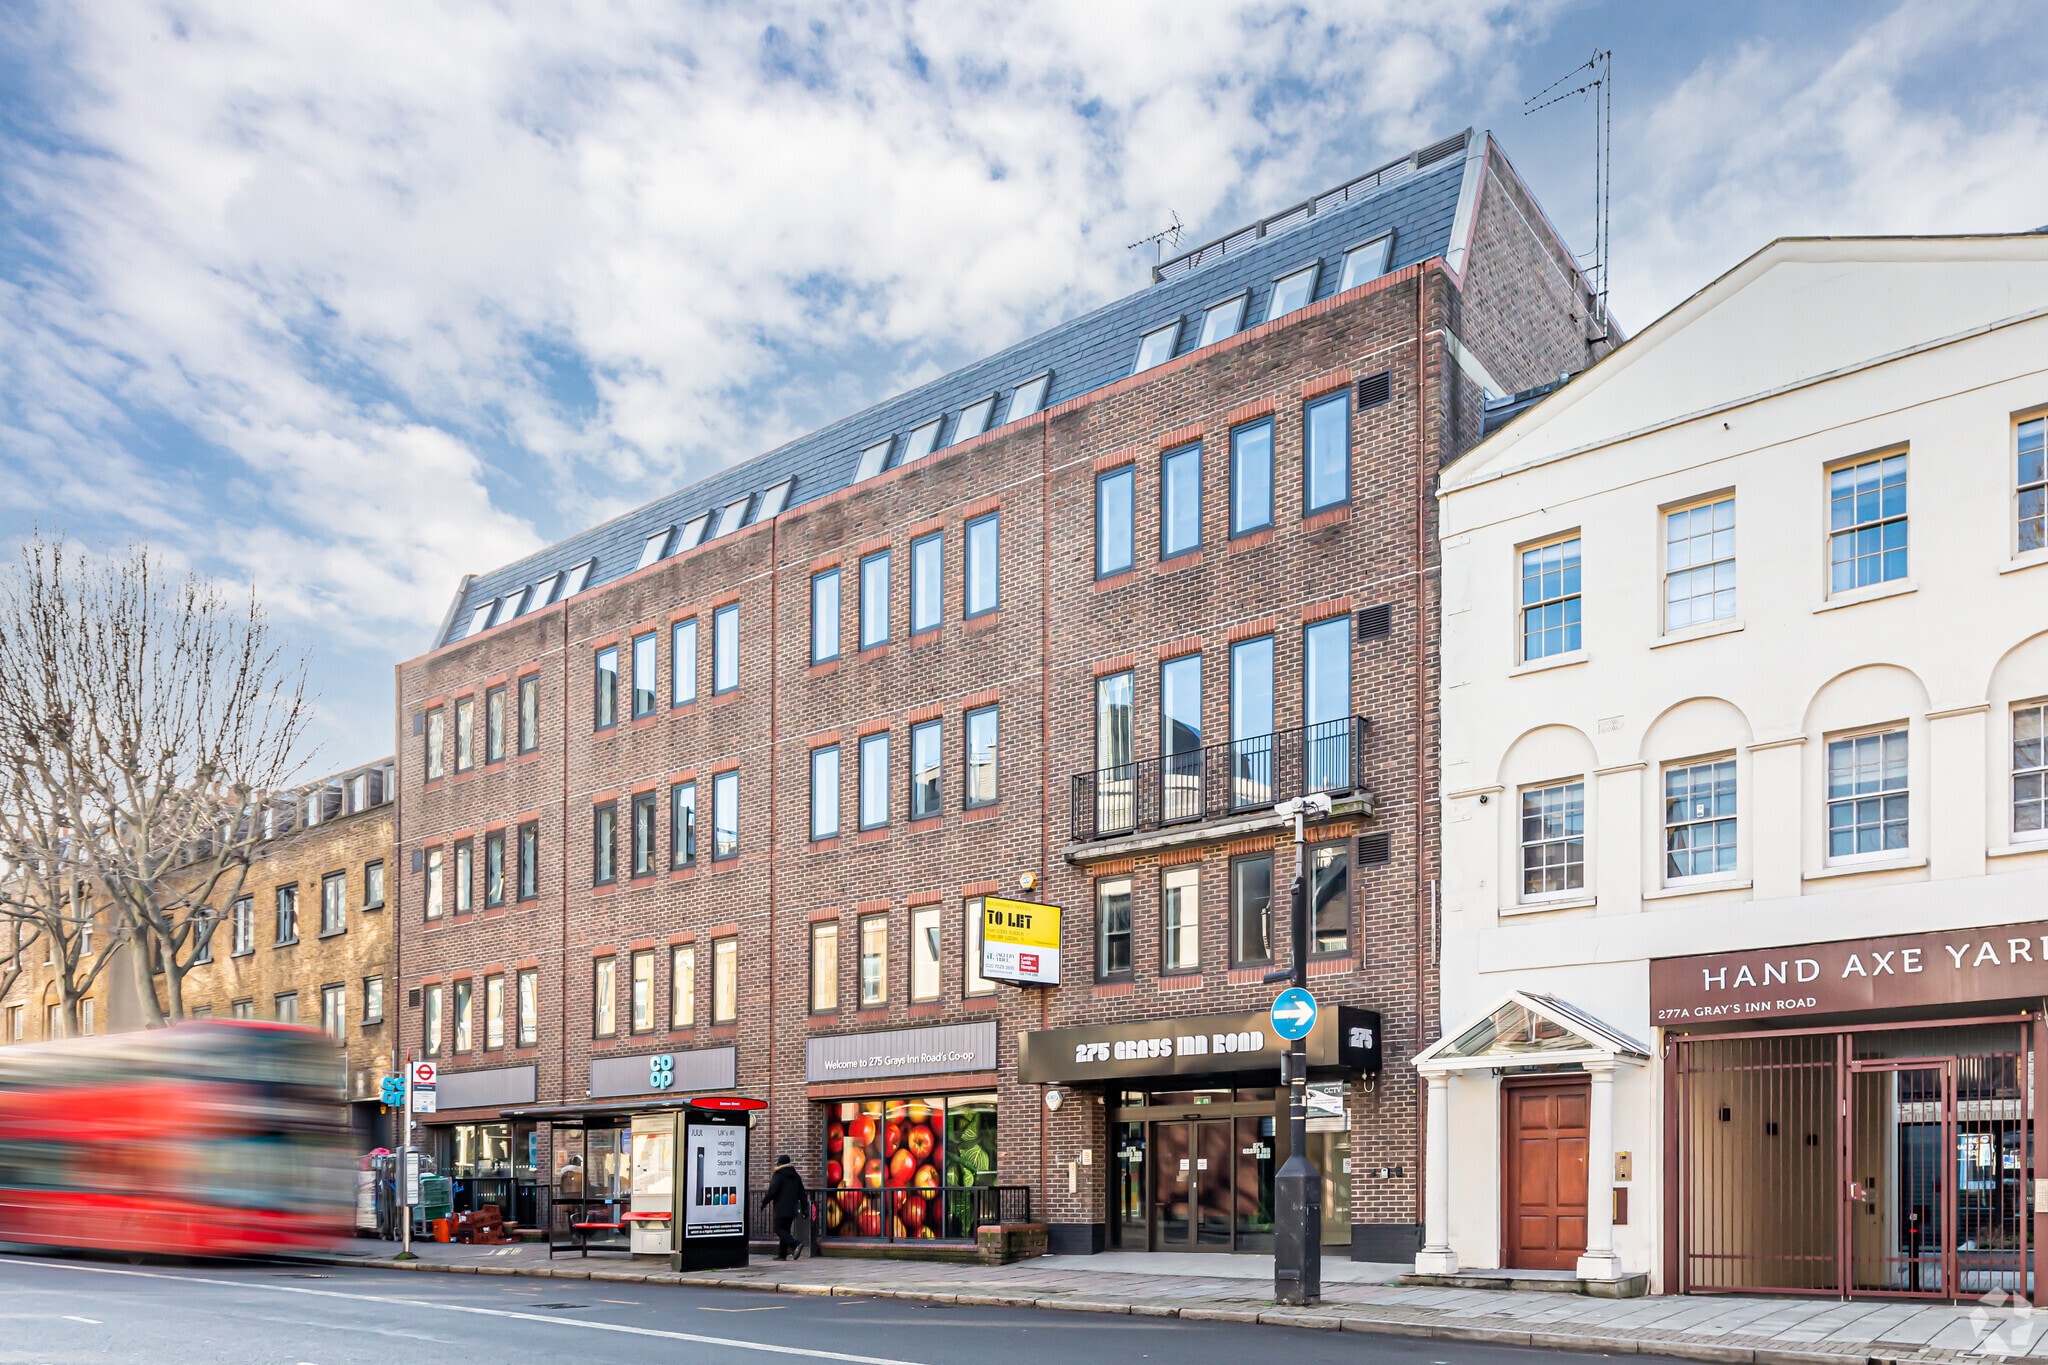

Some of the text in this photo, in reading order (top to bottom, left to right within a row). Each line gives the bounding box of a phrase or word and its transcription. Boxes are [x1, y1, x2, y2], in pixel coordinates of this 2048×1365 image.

[987, 910, 1032, 929] TO LET
[1702, 958, 1821, 991] HAND
[1841, 948, 1924, 979] AXE
[1658, 997, 1818, 1020] 277A GRAY'S INN ROAD
[1075, 1030, 1264, 1063] 275 GRAYS INN ROAD
[1348, 1027, 1372, 1050] 275
[824, 1050, 975, 1071] Welcome to 275 Grays Inn Road's Co-op
[1323, 1086, 1341, 1094] CCTV
